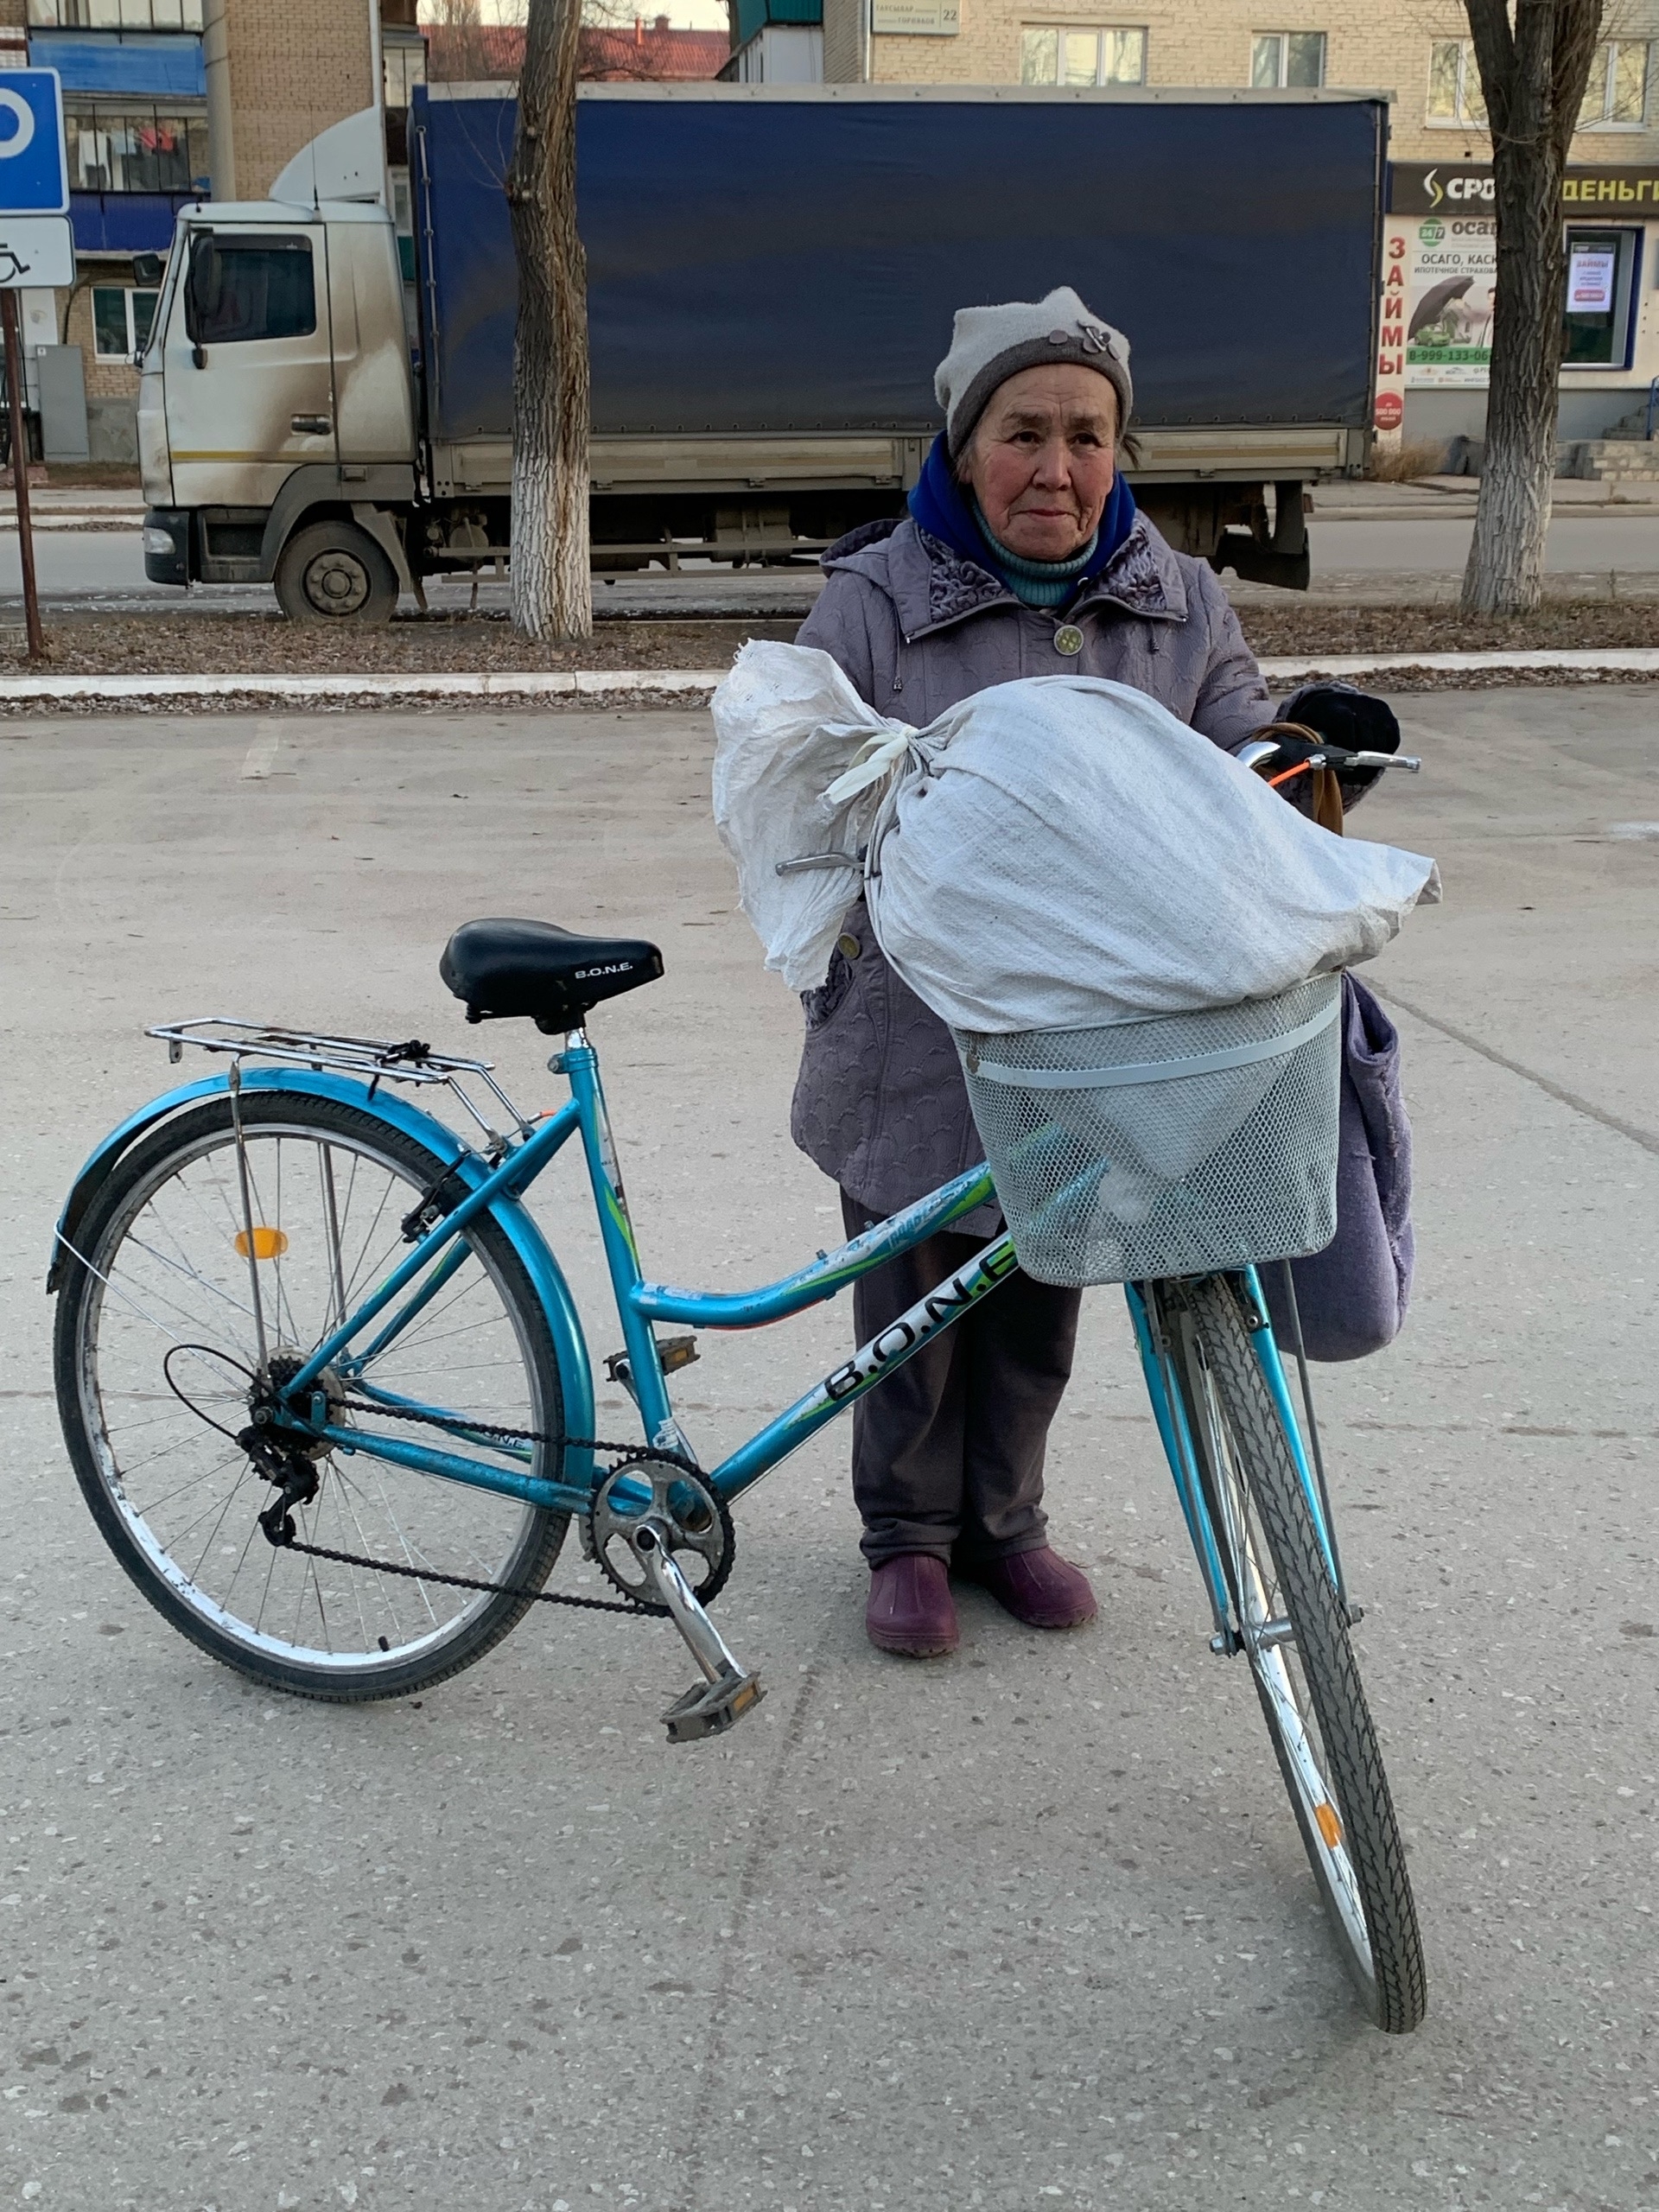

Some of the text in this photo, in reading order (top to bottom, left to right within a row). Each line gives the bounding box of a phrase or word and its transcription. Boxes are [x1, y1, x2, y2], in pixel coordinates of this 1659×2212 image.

[943, 9, 957, 21] 22
[1421, 253, 1464, 266] ОСАГО,
[1378, 236, 1406, 375] ЗАЙМЫ
